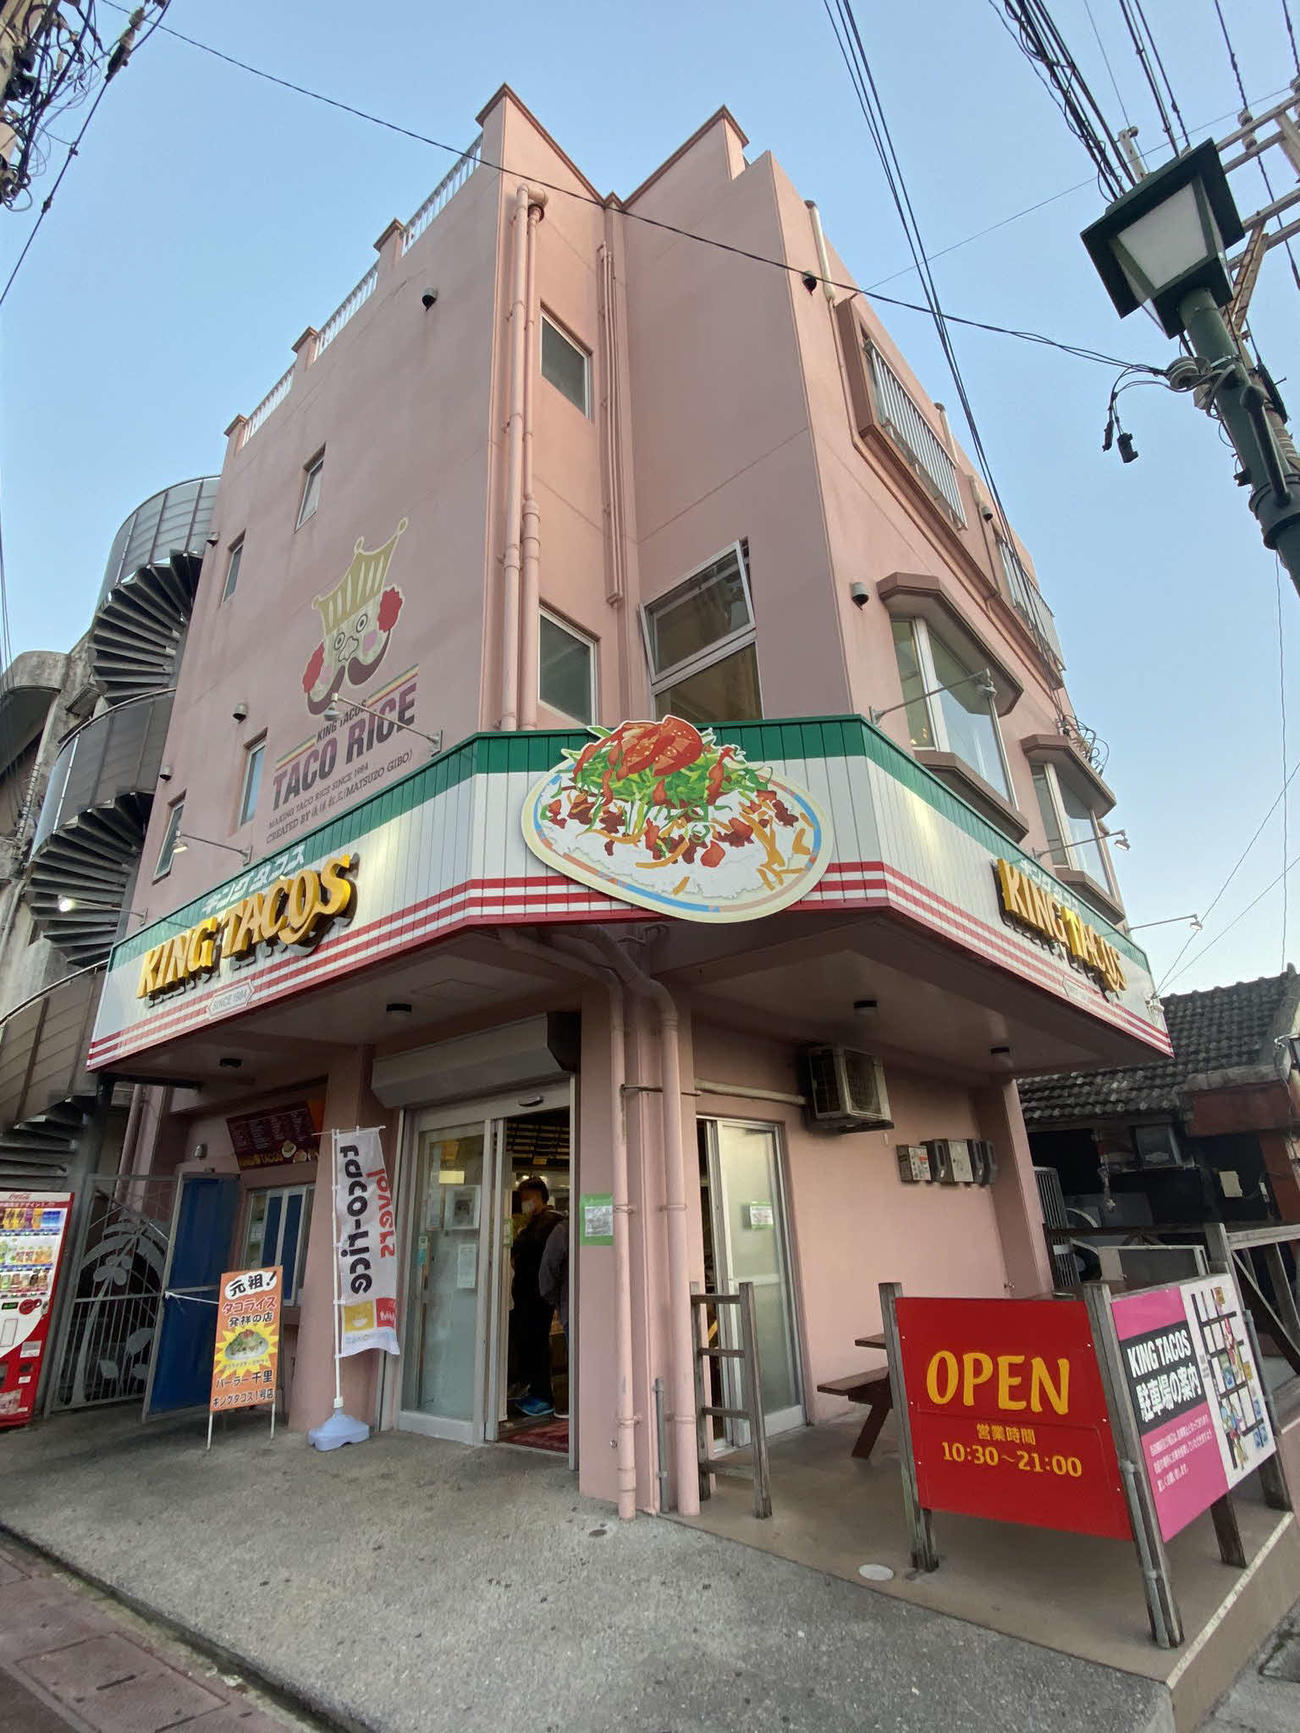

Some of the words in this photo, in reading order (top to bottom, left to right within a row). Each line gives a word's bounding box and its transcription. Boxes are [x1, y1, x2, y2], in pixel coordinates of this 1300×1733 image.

[273, 738, 338, 810] TACO
[345, 683, 417, 764] RICE
[316, 719, 337, 743] KING
[996, 858, 1069, 947] KING
[137, 916, 218, 999] KING
[221, 854, 351, 959] TACOS
[222, 1296, 277, 1315] タコライス
[229, 1270, 277, 1298] 元祖!
[229, 1311, 274, 1328] 発祥の店
[1127, 1339, 1156, 1378] KING
[1156, 1329, 1192, 1368] TACOS
[926, 1350, 1070, 1416] OPEN
[1136, 1361, 1202, 1424] 駐車場の案内
[976, 1423, 1036, 1446] 営業時間
[942, 1441, 1083, 1478] 10:30~21:00
